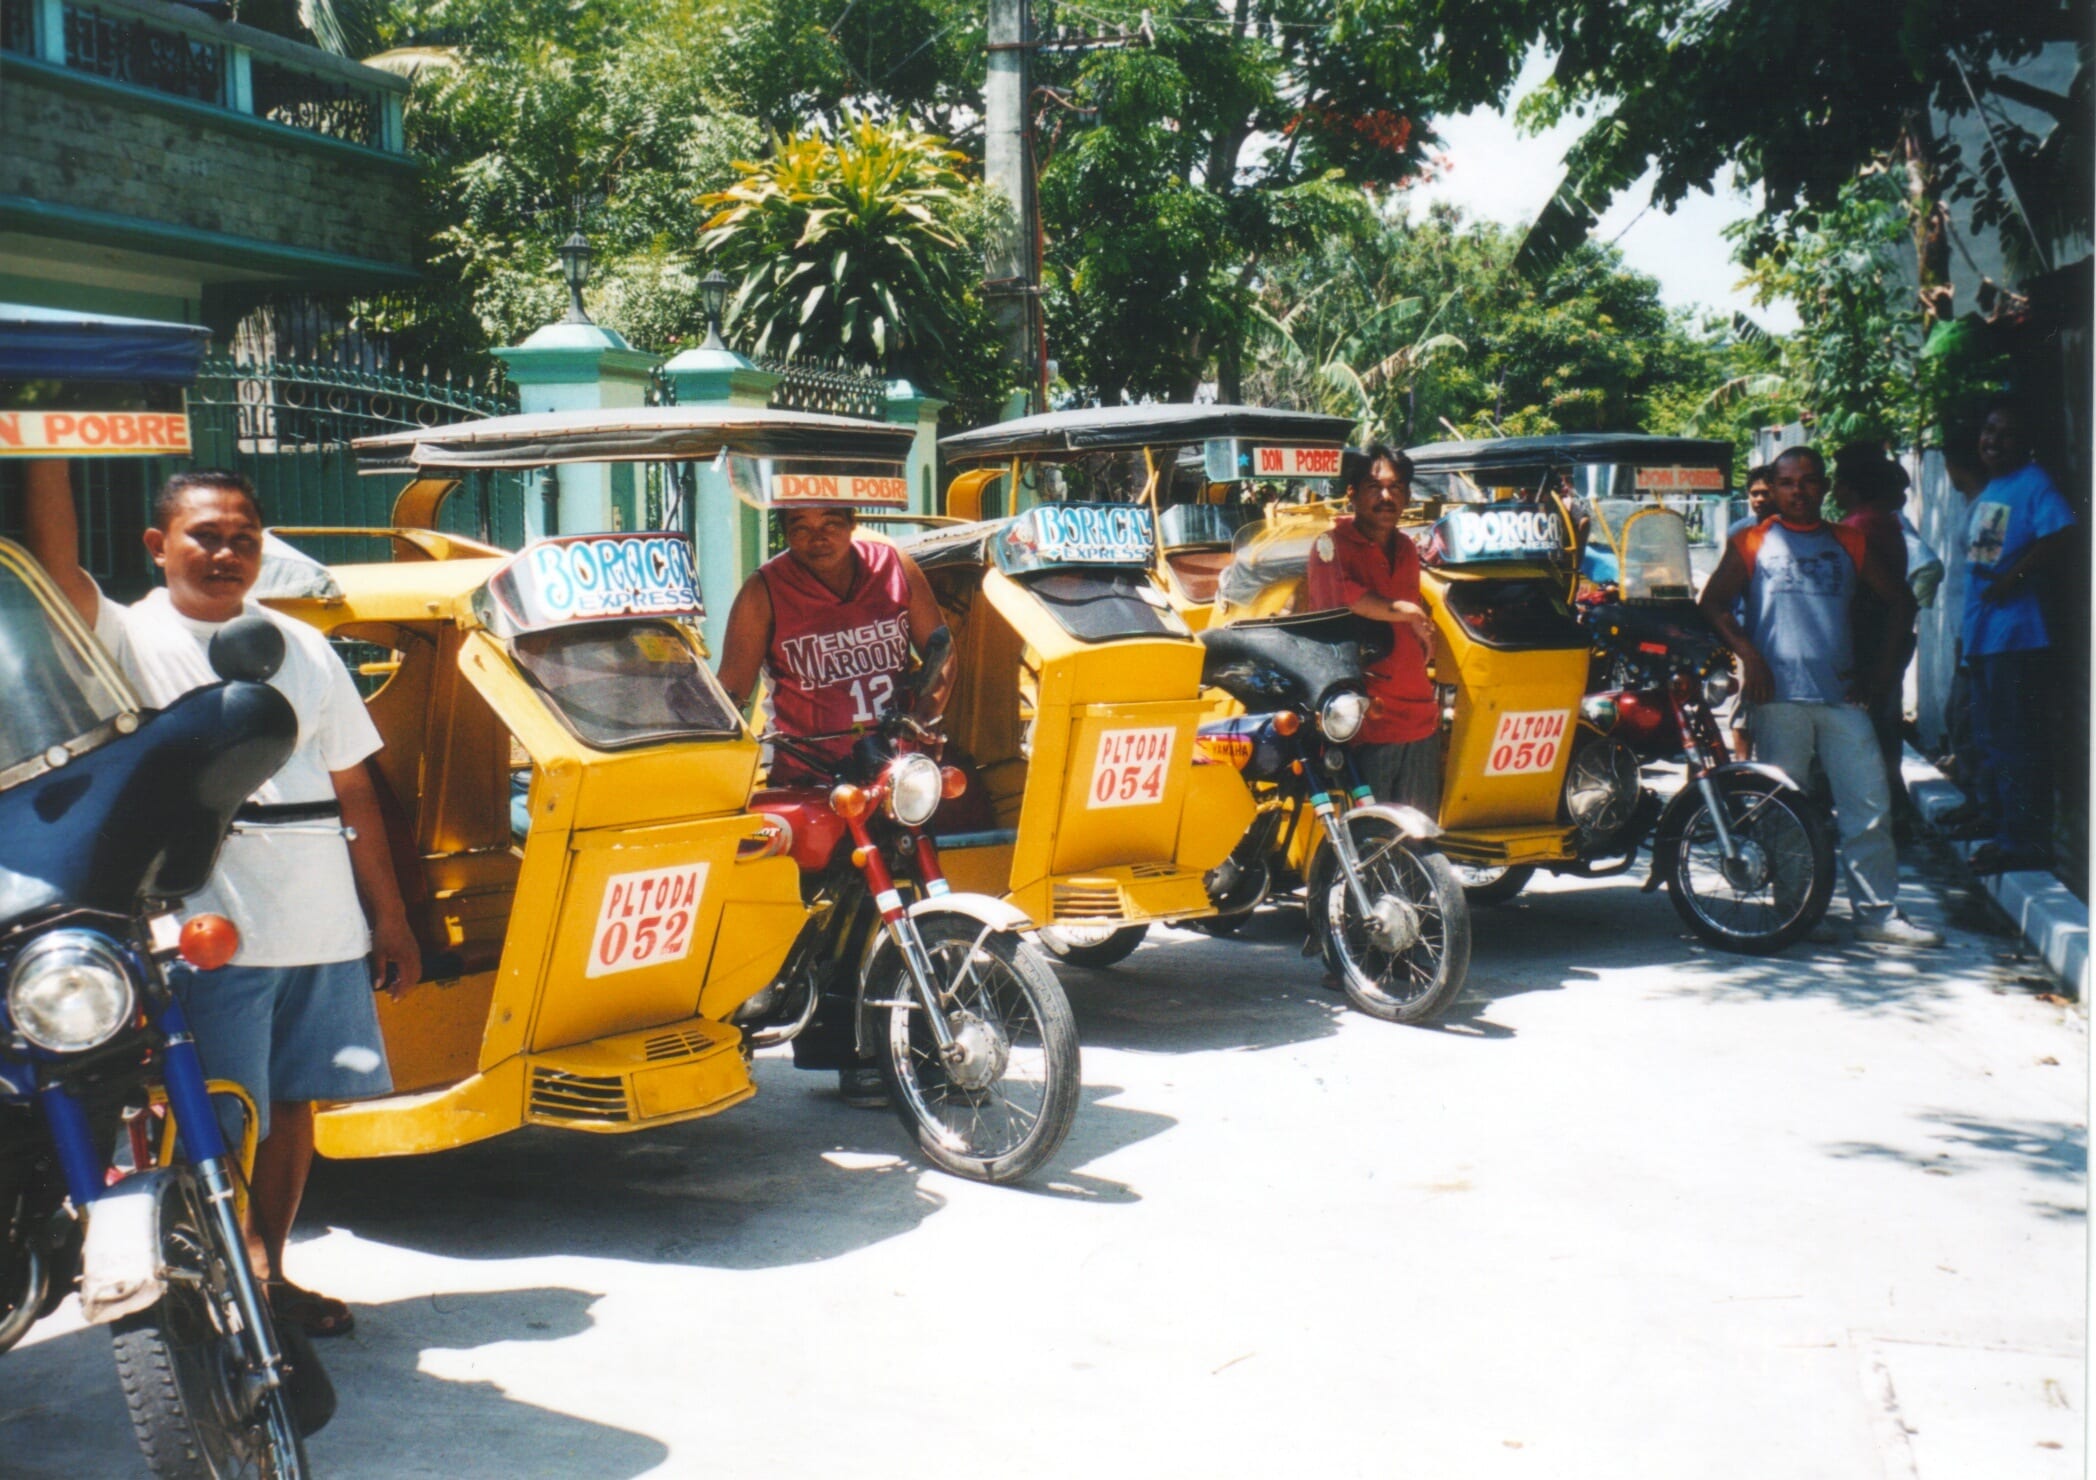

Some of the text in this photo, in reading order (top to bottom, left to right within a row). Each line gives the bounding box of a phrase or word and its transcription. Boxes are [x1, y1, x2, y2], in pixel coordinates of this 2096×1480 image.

[44, 414, 187, 446] POBRE
[1261, 449, 1340, 472] DON POBRE
[780, 476, 839, 497] DON
[1039, 507, 1154, 545] BORACAY
[1458, 511, 1562, 552] BORACA
[1064, 547, 1149, 559] EXPRESS
[578, 590, 693, 610] EXPRESS
[850, 674, 894, 723] 12
[1501, 714, 1564, 741] PLTODA
[1102, 733, 1168, 765] PLTODA
[1213, 744, 1249, 757] YAMAHA
[1493, 742, 1555, 771] 050
[1096, 763, 1162, 802] 054
[607, 872, 697, 920] PLTODA
[599, 910, 689, 966] 052
